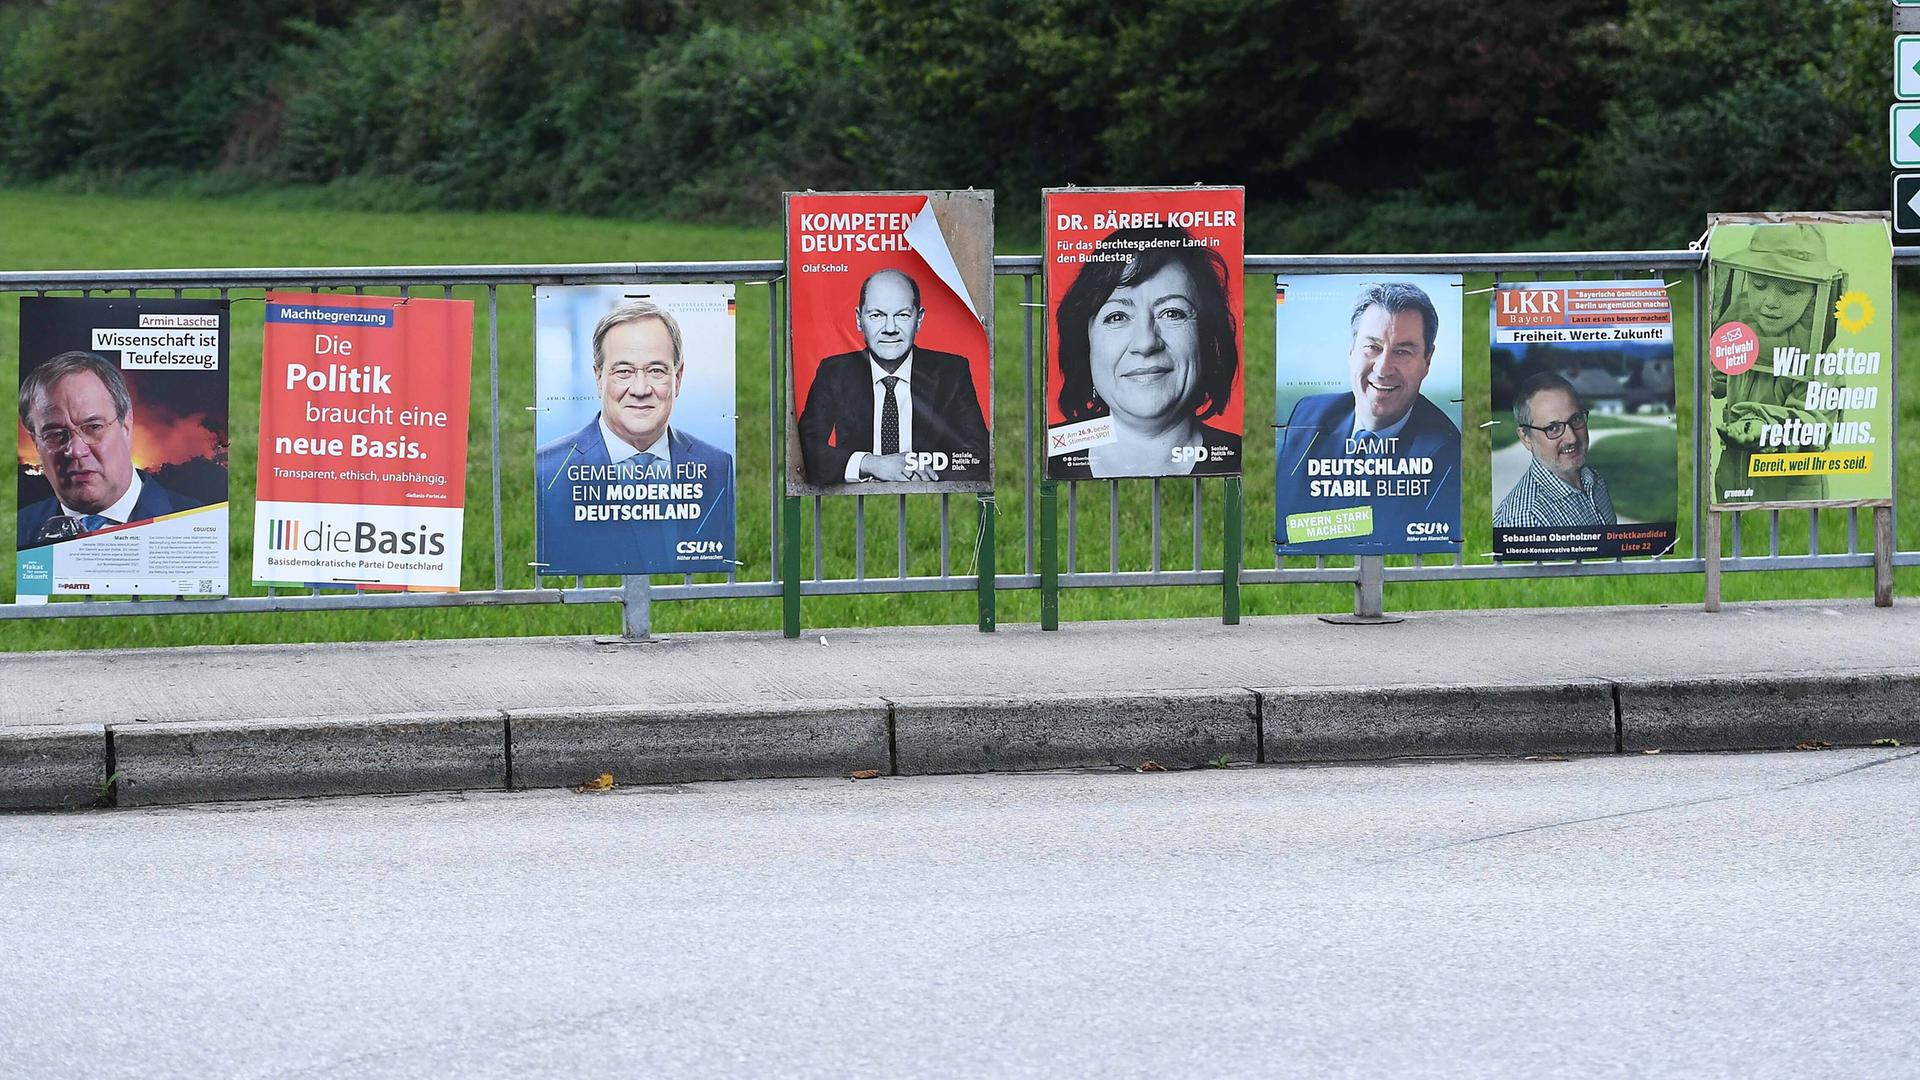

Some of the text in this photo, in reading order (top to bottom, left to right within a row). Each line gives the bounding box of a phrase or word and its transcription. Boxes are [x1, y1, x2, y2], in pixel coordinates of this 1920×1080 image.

[800, 213, 917, 232] KOMPETEN
[1057, 210, 1237, 231] DR. BÄRBEL KOFLER
[801, 234, 912, 252] DEUTSCHL
[1057, 237, 1220, 251] Für das Berchtesgadener Land in
[1057, 252, 1136, 265] den Bundestag.
[802, 264, 848, 273] Olaf Scholz
[1502, 291, 1560, 314] LKR
[1598, 301, 1641, 310] ungemütlich
[142, 316, 217, 327] Armin Laschet
[281, 308, 386, 325] Machtbegrenzung
[1510, 315, 1553, 324] Bayern
[97, 333, 216, 346] Wissenschaft ist
[1513, 329, 1663, 342] Freiheit. Werte. Zukunft!
[315, 334, 352, 355] Die
[1715, 340, 1754, 358] Briefwahl
[127, 351, 216, 368] Teufelszeug.
[1726, 353, 1747, 369] jetzt!
[1773, 347, 1880, 377] Wir retten
[287, 363, 392, 394] Politik
[1805, 381, 1878, 410] Bienen
[306, 401, 447, 427] braucht eine
[1760, 418, 1876, 447] retten uns.
[275, 434, 427, 459] neue Basis.
[1171, 446, 1208, 463] SPD
[1345, 438, 1399, 455] DAMIT
[904, 452, 949, 472] SPD
[1308, 458, 1433, 476] DEUTSCHLAND
[1753, 456, 1867, 472] Bereit, weil Ihr es seid.
[273, 467, 447, 486] Transparent, ethisch, unabhängig.
[567, 461, 707, 481] GEMEINSAM FÜR
[572, 483, 703, 501] EIN MODERNES
[1310, 479, 1431, 497] STABIL BLEIBT
[1724, 488, 1754, 499] gruene.de
[574, 503, 701, 521] DEUTSCHLAND
[1290, 510, 1370, 529] BAYERN STARK
[1306, 523, 1356, 537] MACHEN!
[1406, 522, 1436, 535] CSU
[1607, 530, 1667, 540] Direktkandidat
[304, 521, 445, 556] dieBasis
[1503, 533, 1601, 543] Sebastian Oberholzner
[1621, 542, 1651, 551] Liste 22
[676, 541, 708, 554] CSU
[1506, 546, 1570, 554] Liberal-Konservative
[268, 557, 443, 571] Basisdemokratische Partei Deutschland
